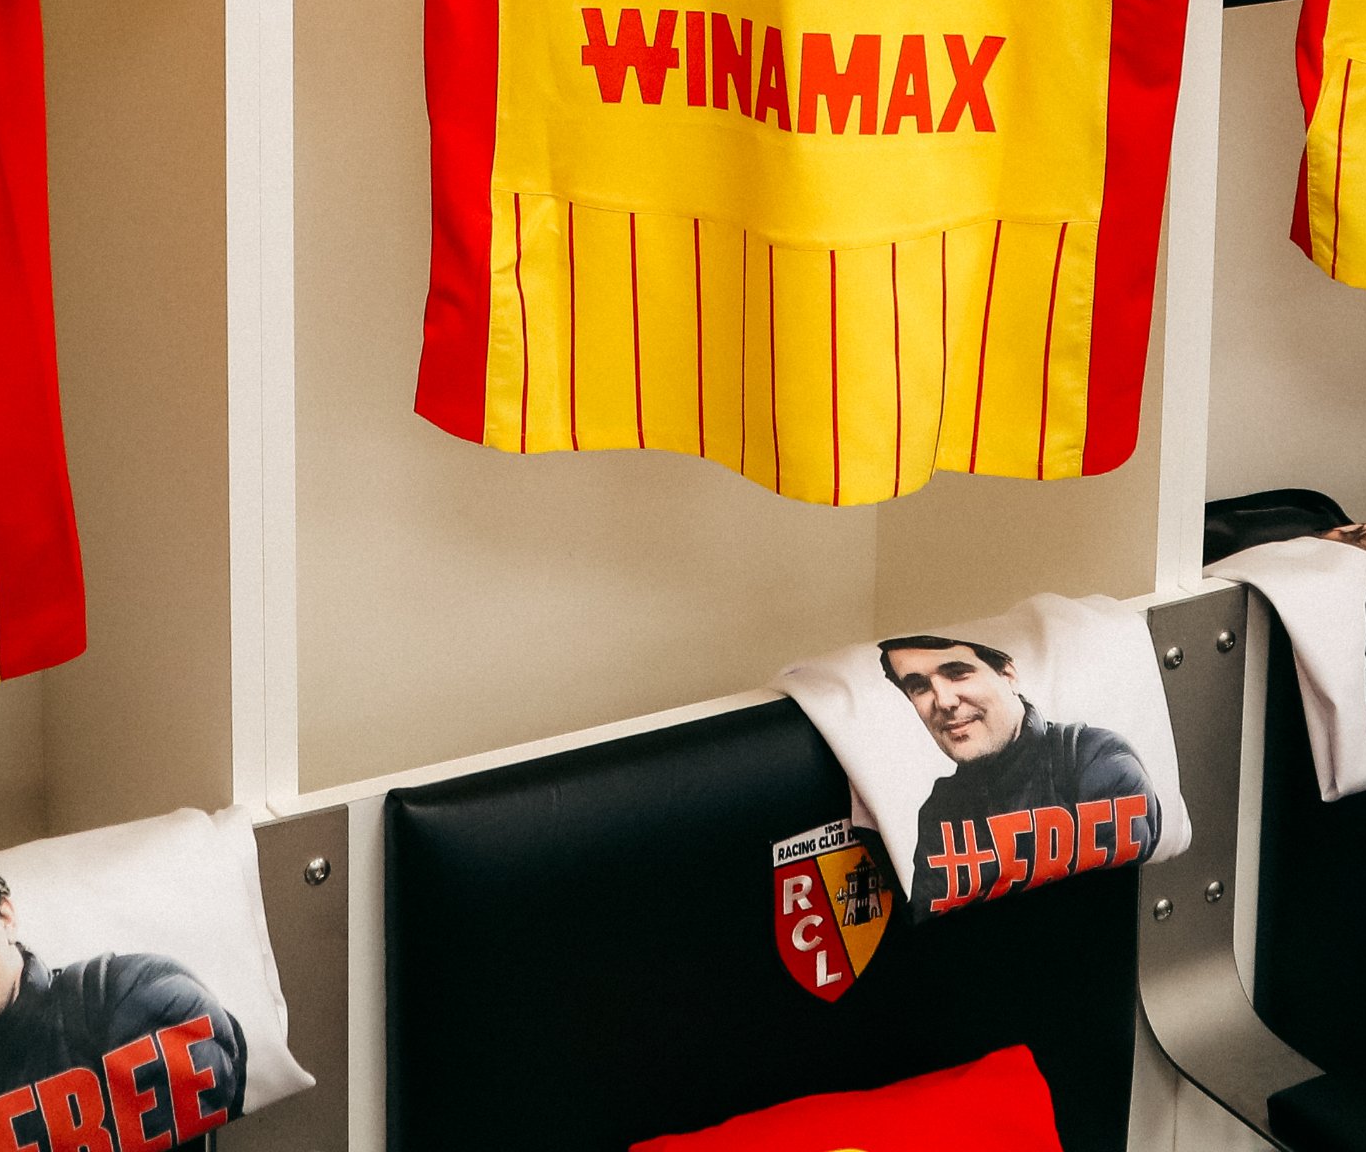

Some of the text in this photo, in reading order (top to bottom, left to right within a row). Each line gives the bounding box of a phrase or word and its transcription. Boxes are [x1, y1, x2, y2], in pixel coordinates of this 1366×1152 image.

[581, 7, 1007, 135] WINAMAX
[778, 838, 817, 861] RACING
[818, 831, 846, 850] CLUB
[782, 874, 843, 988] RCL
